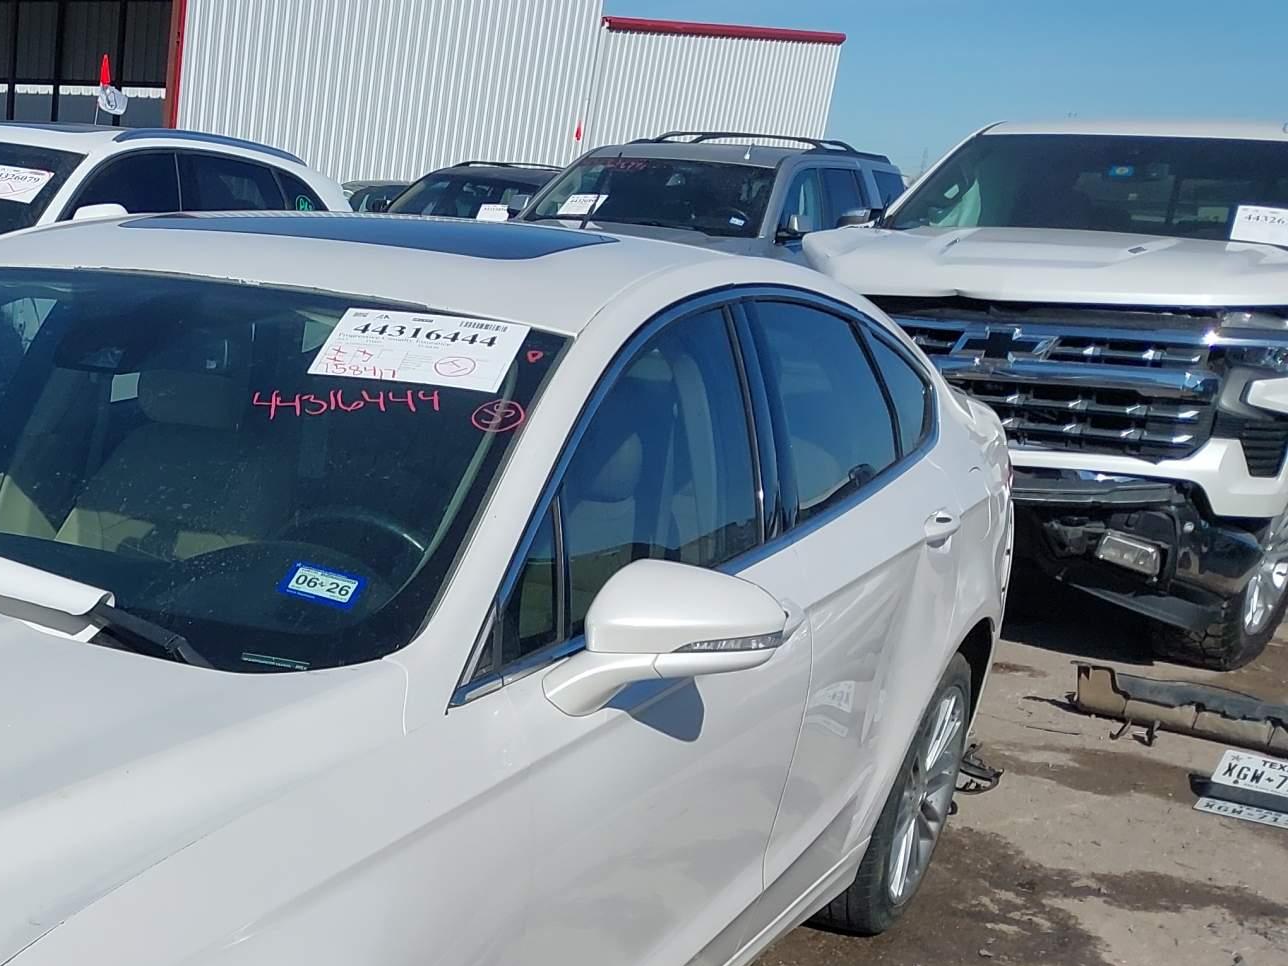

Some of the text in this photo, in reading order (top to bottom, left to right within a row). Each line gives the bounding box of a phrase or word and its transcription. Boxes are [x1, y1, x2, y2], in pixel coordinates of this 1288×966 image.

[353, 322, 498, 348] 44316444
[253, 390, 440, 420] 44316444
[1261, 759, 1288, 772] TEX
